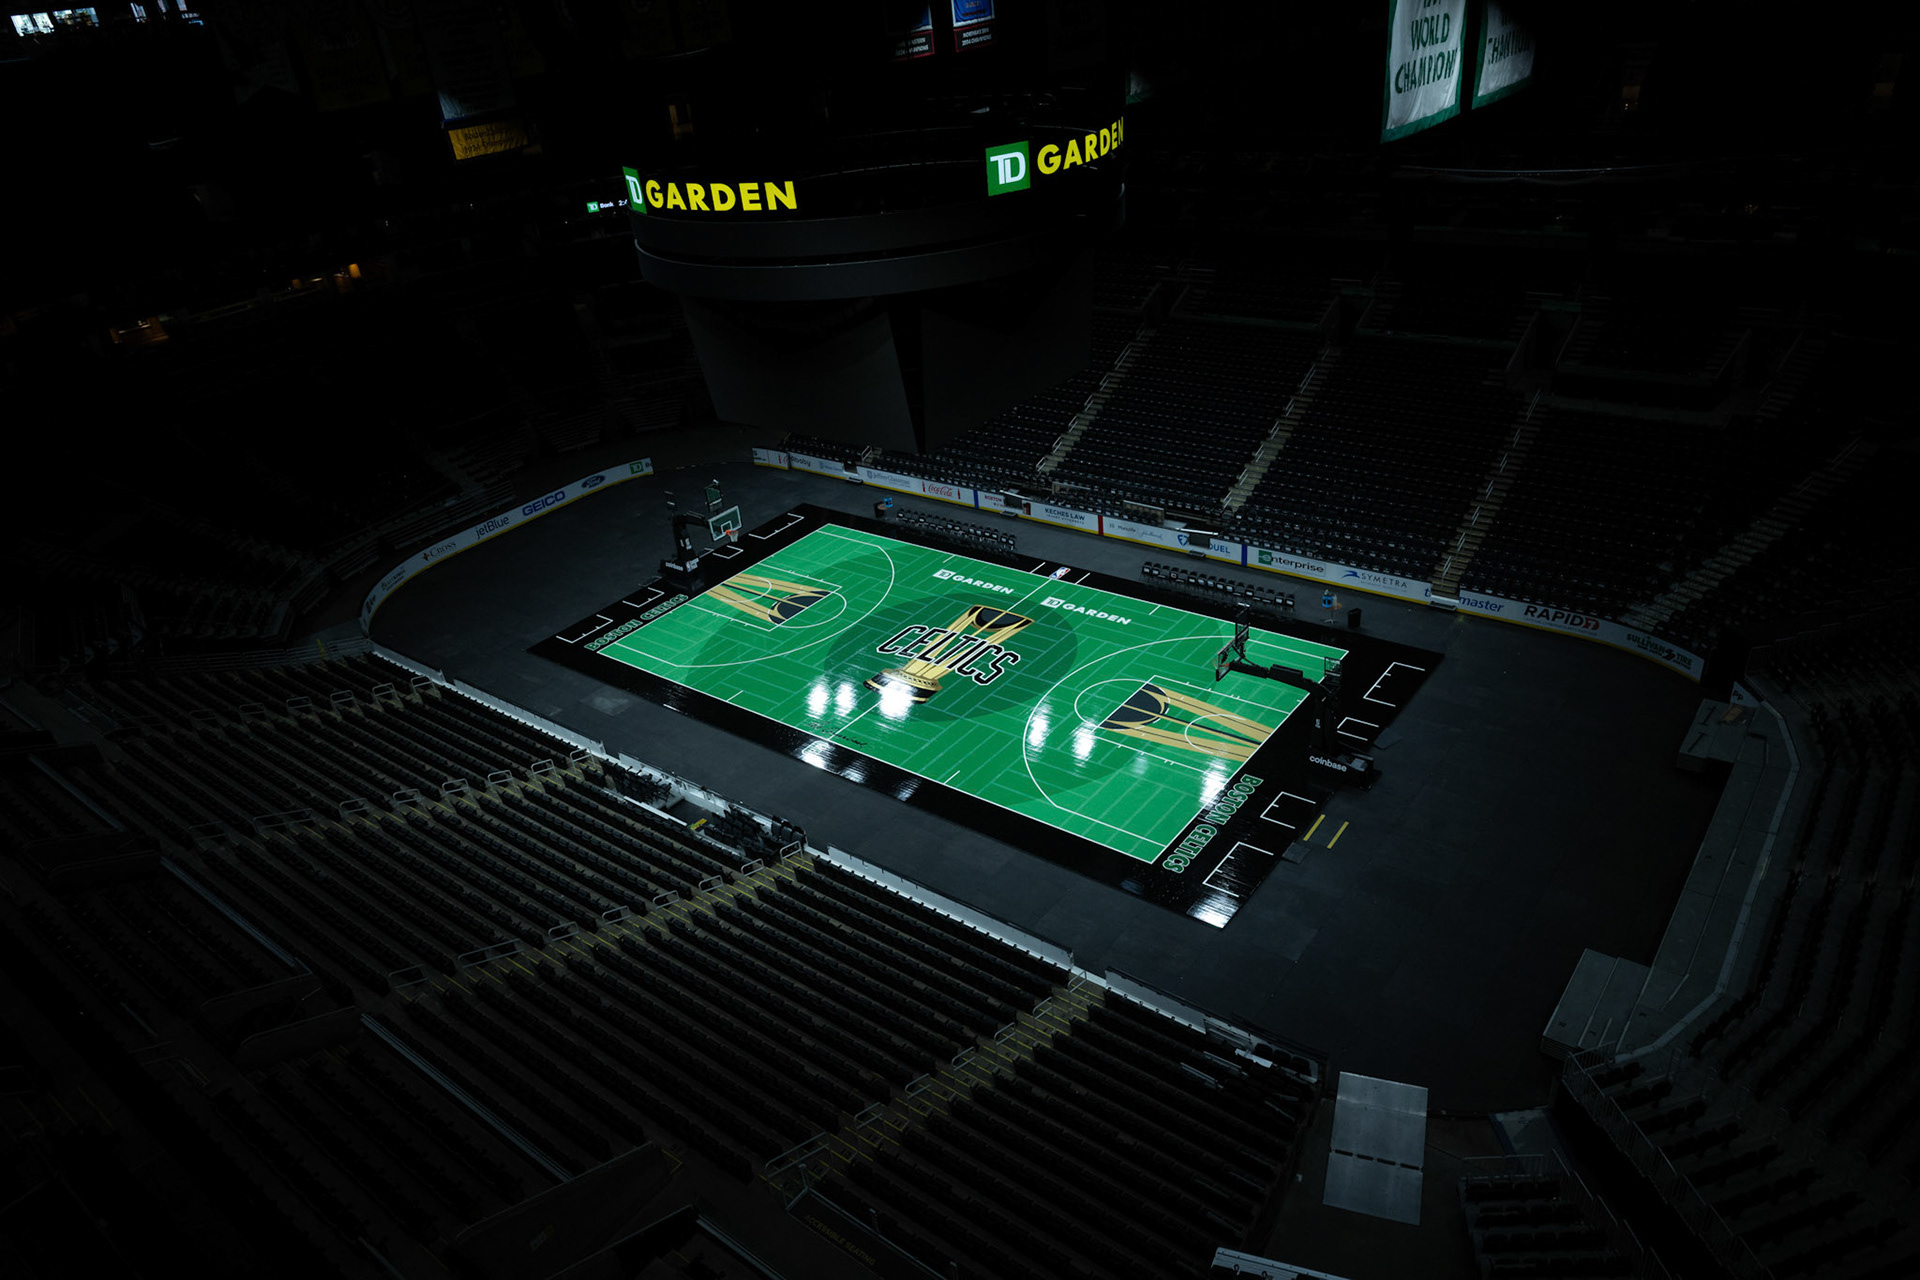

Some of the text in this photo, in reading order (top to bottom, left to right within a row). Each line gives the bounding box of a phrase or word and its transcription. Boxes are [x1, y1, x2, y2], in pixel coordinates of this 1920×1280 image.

[1411, 13, 1450, 50] WORLD
[990, 116, 1124, 185] TD GARDEN
[645, 179, 798, 212] GARDEN
[522, 490, 566, 516] GEICO
[475, 516, 509, 540] jetBlue
[1070, 513, 1085, 521] LAW
[951, 574, 1015, 595] GARDEN
[1360, 572, 1408, 589] SYMETRA
[583, 593, 689, 652] BOSTON CELTICS
[1061, 602, 1132, 626] GARDEN
[876, 624, 1021, 686] CELTICS
[1309, 755, 1348, 773] coinbase
[1162, 773, 1265, 874] BOSTON CELTICS
